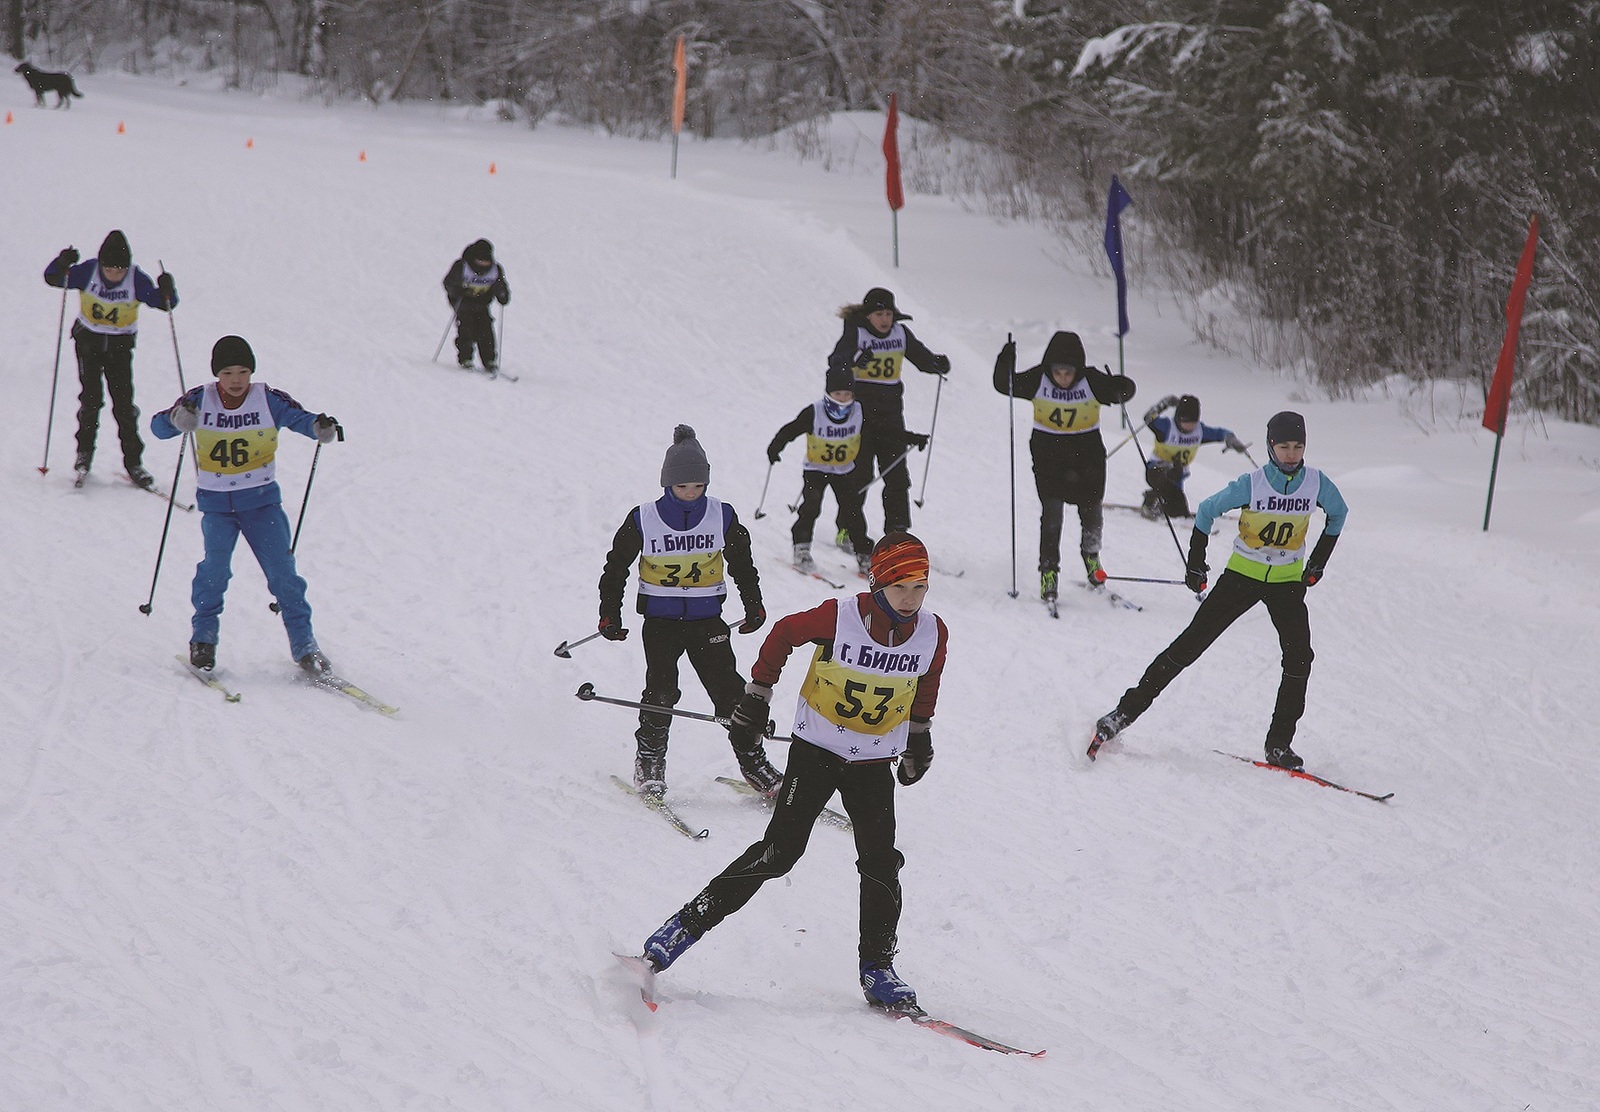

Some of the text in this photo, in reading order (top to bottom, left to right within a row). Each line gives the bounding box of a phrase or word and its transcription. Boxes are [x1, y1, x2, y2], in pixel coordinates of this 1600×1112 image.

[92, 303, 118, 323] 64
[868, 357, 894, 378] 38
[1051, 387, 1087, 401] Бирск
[203, 411, 260, 429] г. Бирск
[1049, 407, 1078, 428] 47
[209, 438, 249, 468] 46
[821, 443, 848, 462] 36
[1256, 496, 1311, 512] г. Бирск
[651, 534, 715, 553] г. Бирск
[1258, 521, 1294, 546] 40
[660, 562, 702, 587] 34
[840, 643, 921, 673] г. Бирск
[835, 679, 894, 725] 53
